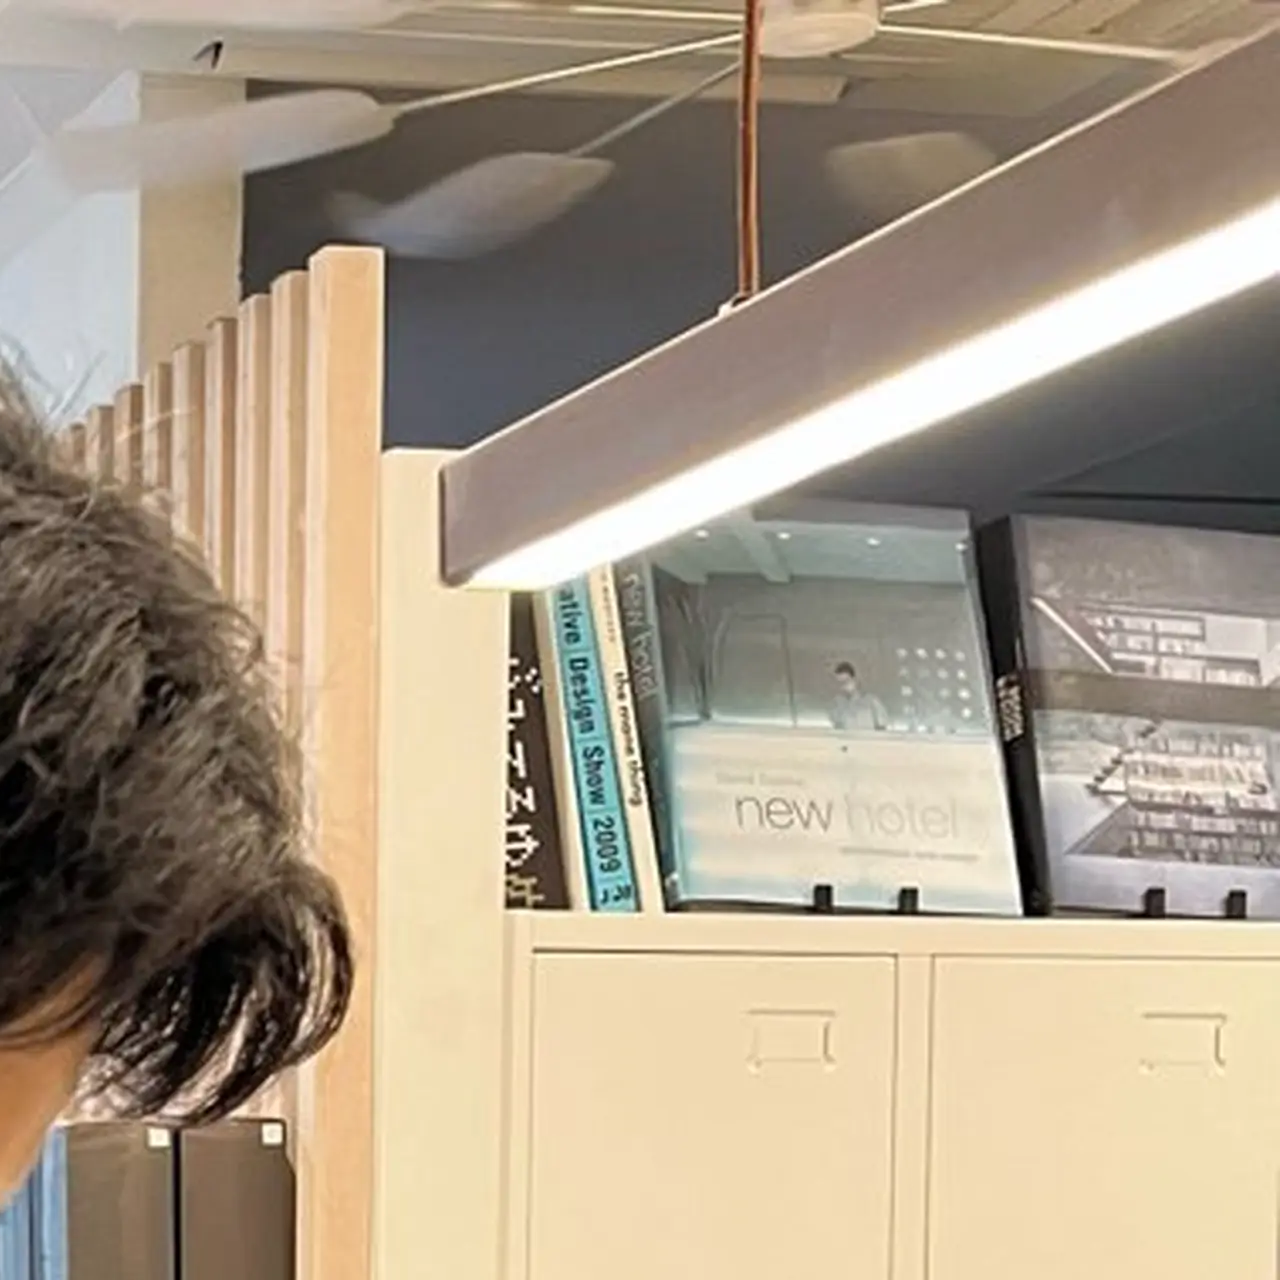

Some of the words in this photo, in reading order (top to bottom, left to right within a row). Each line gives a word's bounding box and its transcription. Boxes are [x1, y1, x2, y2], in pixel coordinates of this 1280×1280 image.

[568, 656, 596, 735] Design
[582, 745, 606, 807] Show
[734, 795, 834, 833] new
[843, 789, 958, 839] hotel
[592, 816, 623, 874] 2009
